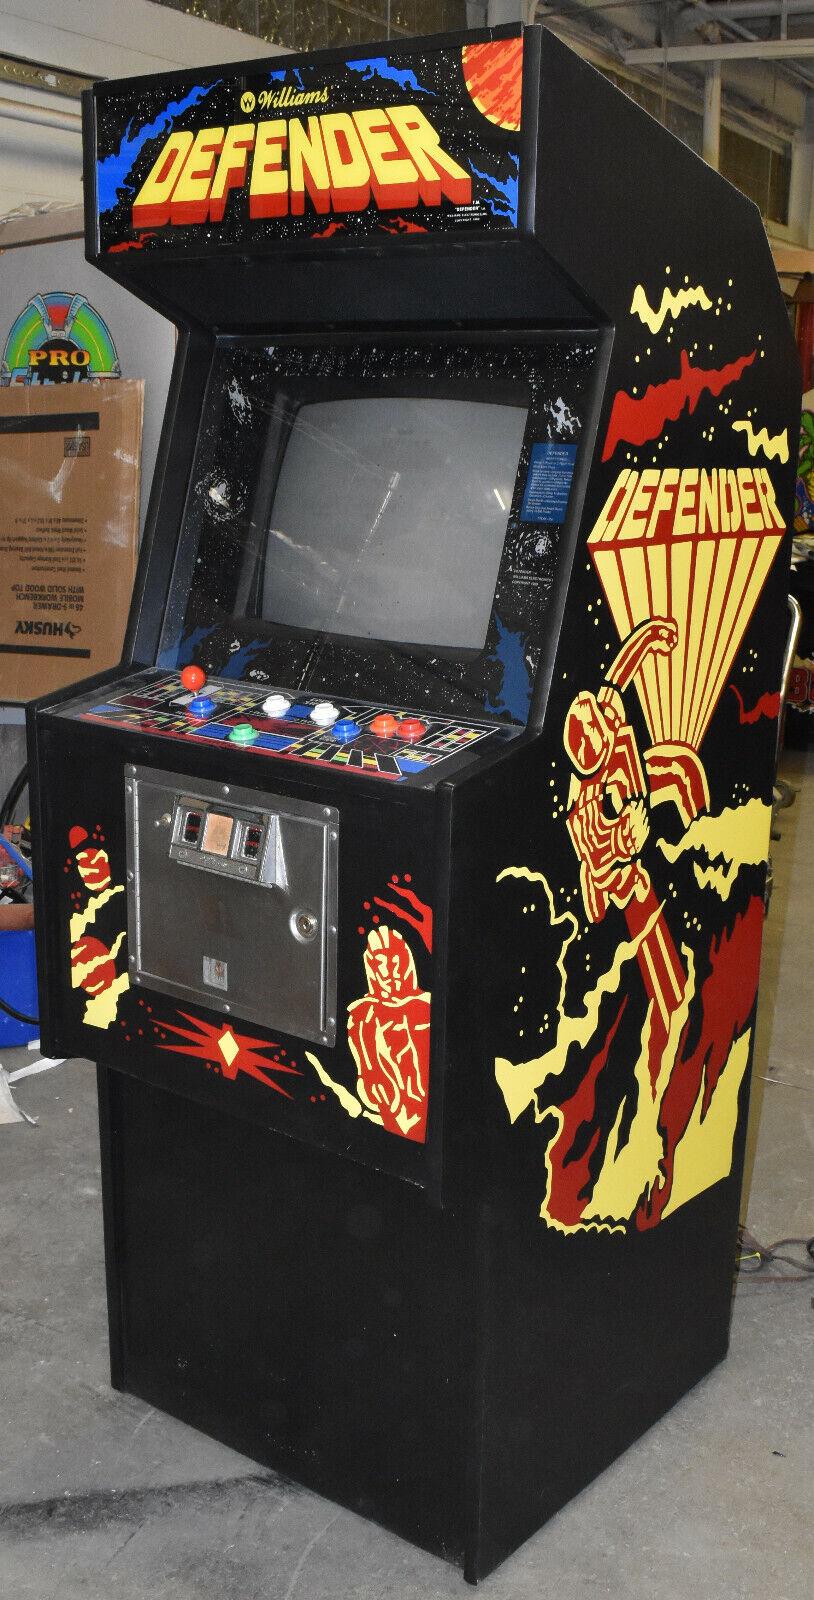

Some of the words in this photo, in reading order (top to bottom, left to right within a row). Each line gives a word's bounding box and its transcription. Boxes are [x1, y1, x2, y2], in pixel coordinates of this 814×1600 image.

[257, 86, 330, 110] Williams
[132, 104, 471, 228] DEFENDER
[28, 349, 91, 366] PRO
[587, 468, 786, 543] DEFENDER
[11, 584, 23, 592] TOP
[25, 584, 46, 593] WOOD
[47, 585, 66, 593] SOLID
[68, 586, 85, 594] WITH
[16, 593, 57, 602] WORKBENCH
[59, 594, 84, 603] MOBILE
[15, 621, 63, 637] HUSKY
